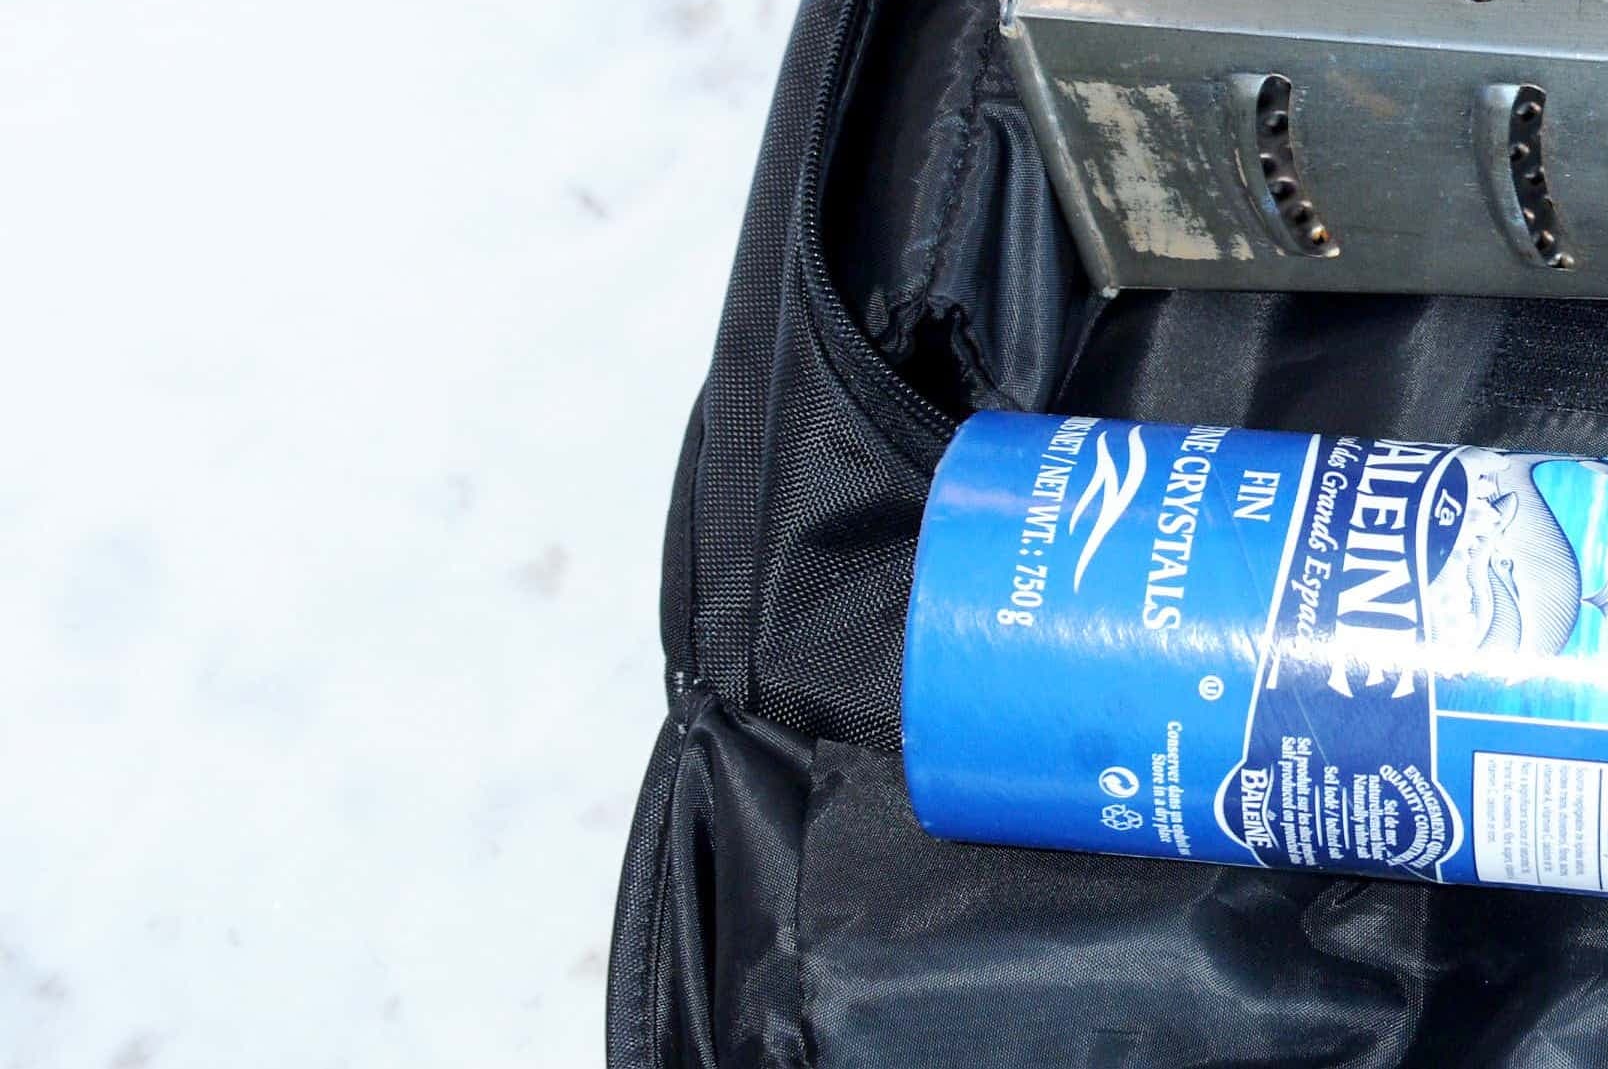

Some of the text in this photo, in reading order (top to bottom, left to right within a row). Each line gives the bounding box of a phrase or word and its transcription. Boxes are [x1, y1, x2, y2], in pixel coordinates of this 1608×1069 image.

[1032, 464, 1073, 502] NET
[1232, 469, 1281, 523] FIN
[1434, 488, 1463, 526] La
[1309, 471, 1347, 553] Grands
[1142, 455, 1212, 630] CRYSTALS
[1011, 564, 1049, 608] 750
[996, 608, 1035, 628] g
[1152, 753, 1168, 784] Store
[1167, 721, 1184, 783] Conserver
[1296, 737, 1313, 755] Sel
[1323, 765, 1340, 784] Sel
[1350, 773, 1369, 823] Naturally
[1379, 764, 1425, 812] QUALITY
[1241, 768, 1273, 848] BALEINE
[1403, 764, 1445, 842] ENGAGEMENT
